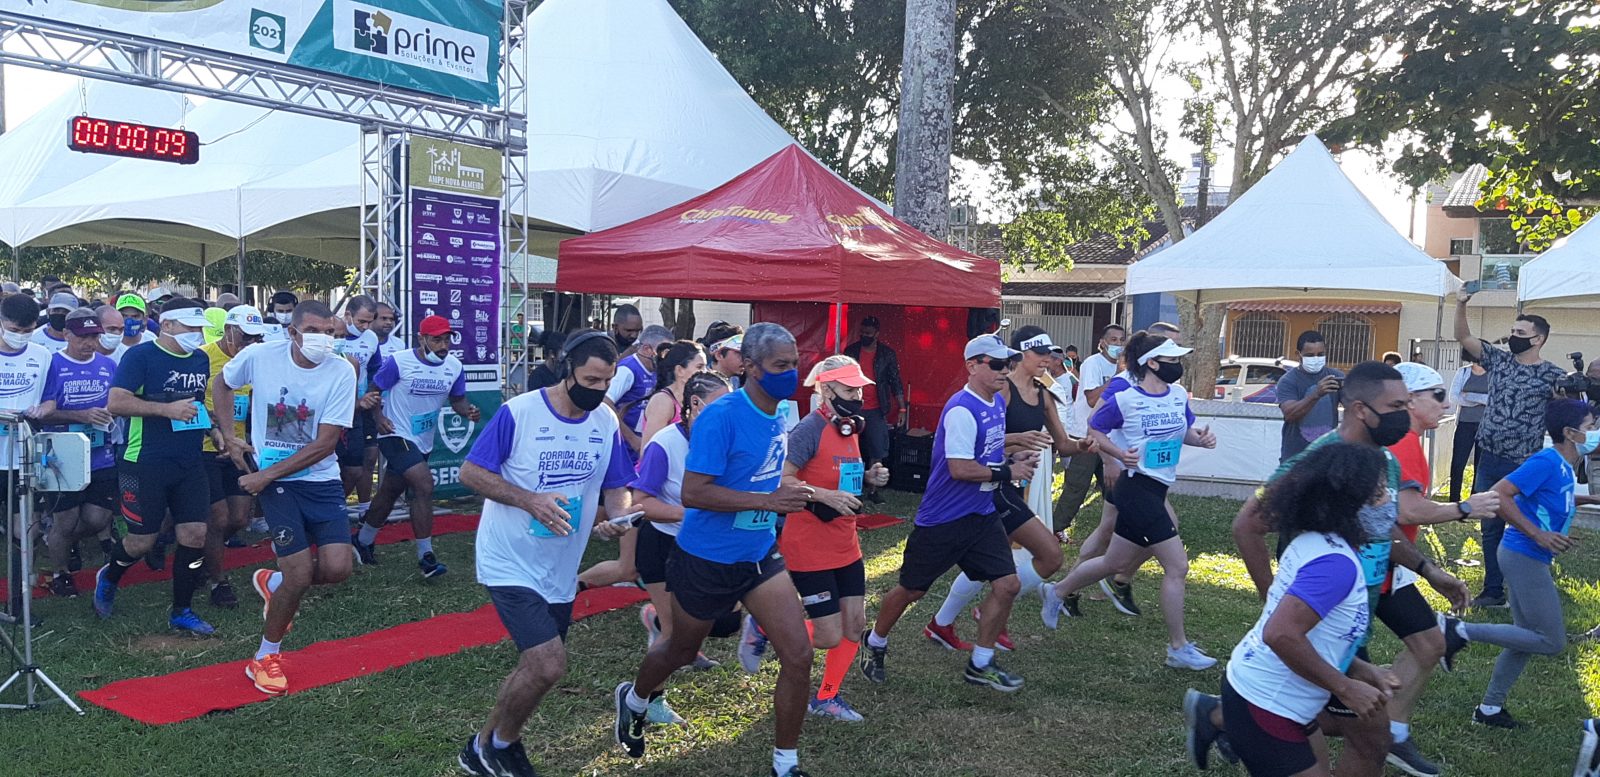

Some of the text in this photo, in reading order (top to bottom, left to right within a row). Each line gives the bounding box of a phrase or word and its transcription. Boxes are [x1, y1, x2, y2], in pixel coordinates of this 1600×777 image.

[252, 24, 281, 40] 2021
[394, 27, 475, 65] prime
[401, 50, 435, 64] Soluções
[446, 62, 474, 74] Eventos
[445, 177, 460, 186] NOVA
[461, 180, 484, 190] ALMEIDA
[1024, 339, 1043, 349] RUN
[3, 378, 30, 386] MAGOS
[64, 380, 90, 388] CORRIDA
[63, 386, 79, 394] REIS
[1142, 413, 1169, 421] CORRIDA
[421, 419, 433, 430] 275
[1142, 420, 1159, 428] REIS
[540, 451, 590, 460] CORRIDA DE
[1157, 451, 1171, 464] 154
[538, 460, 593, 471] REIS MAGOS
[430, 466, 460, 486] SER
[752, 509, 770, 523] 212
